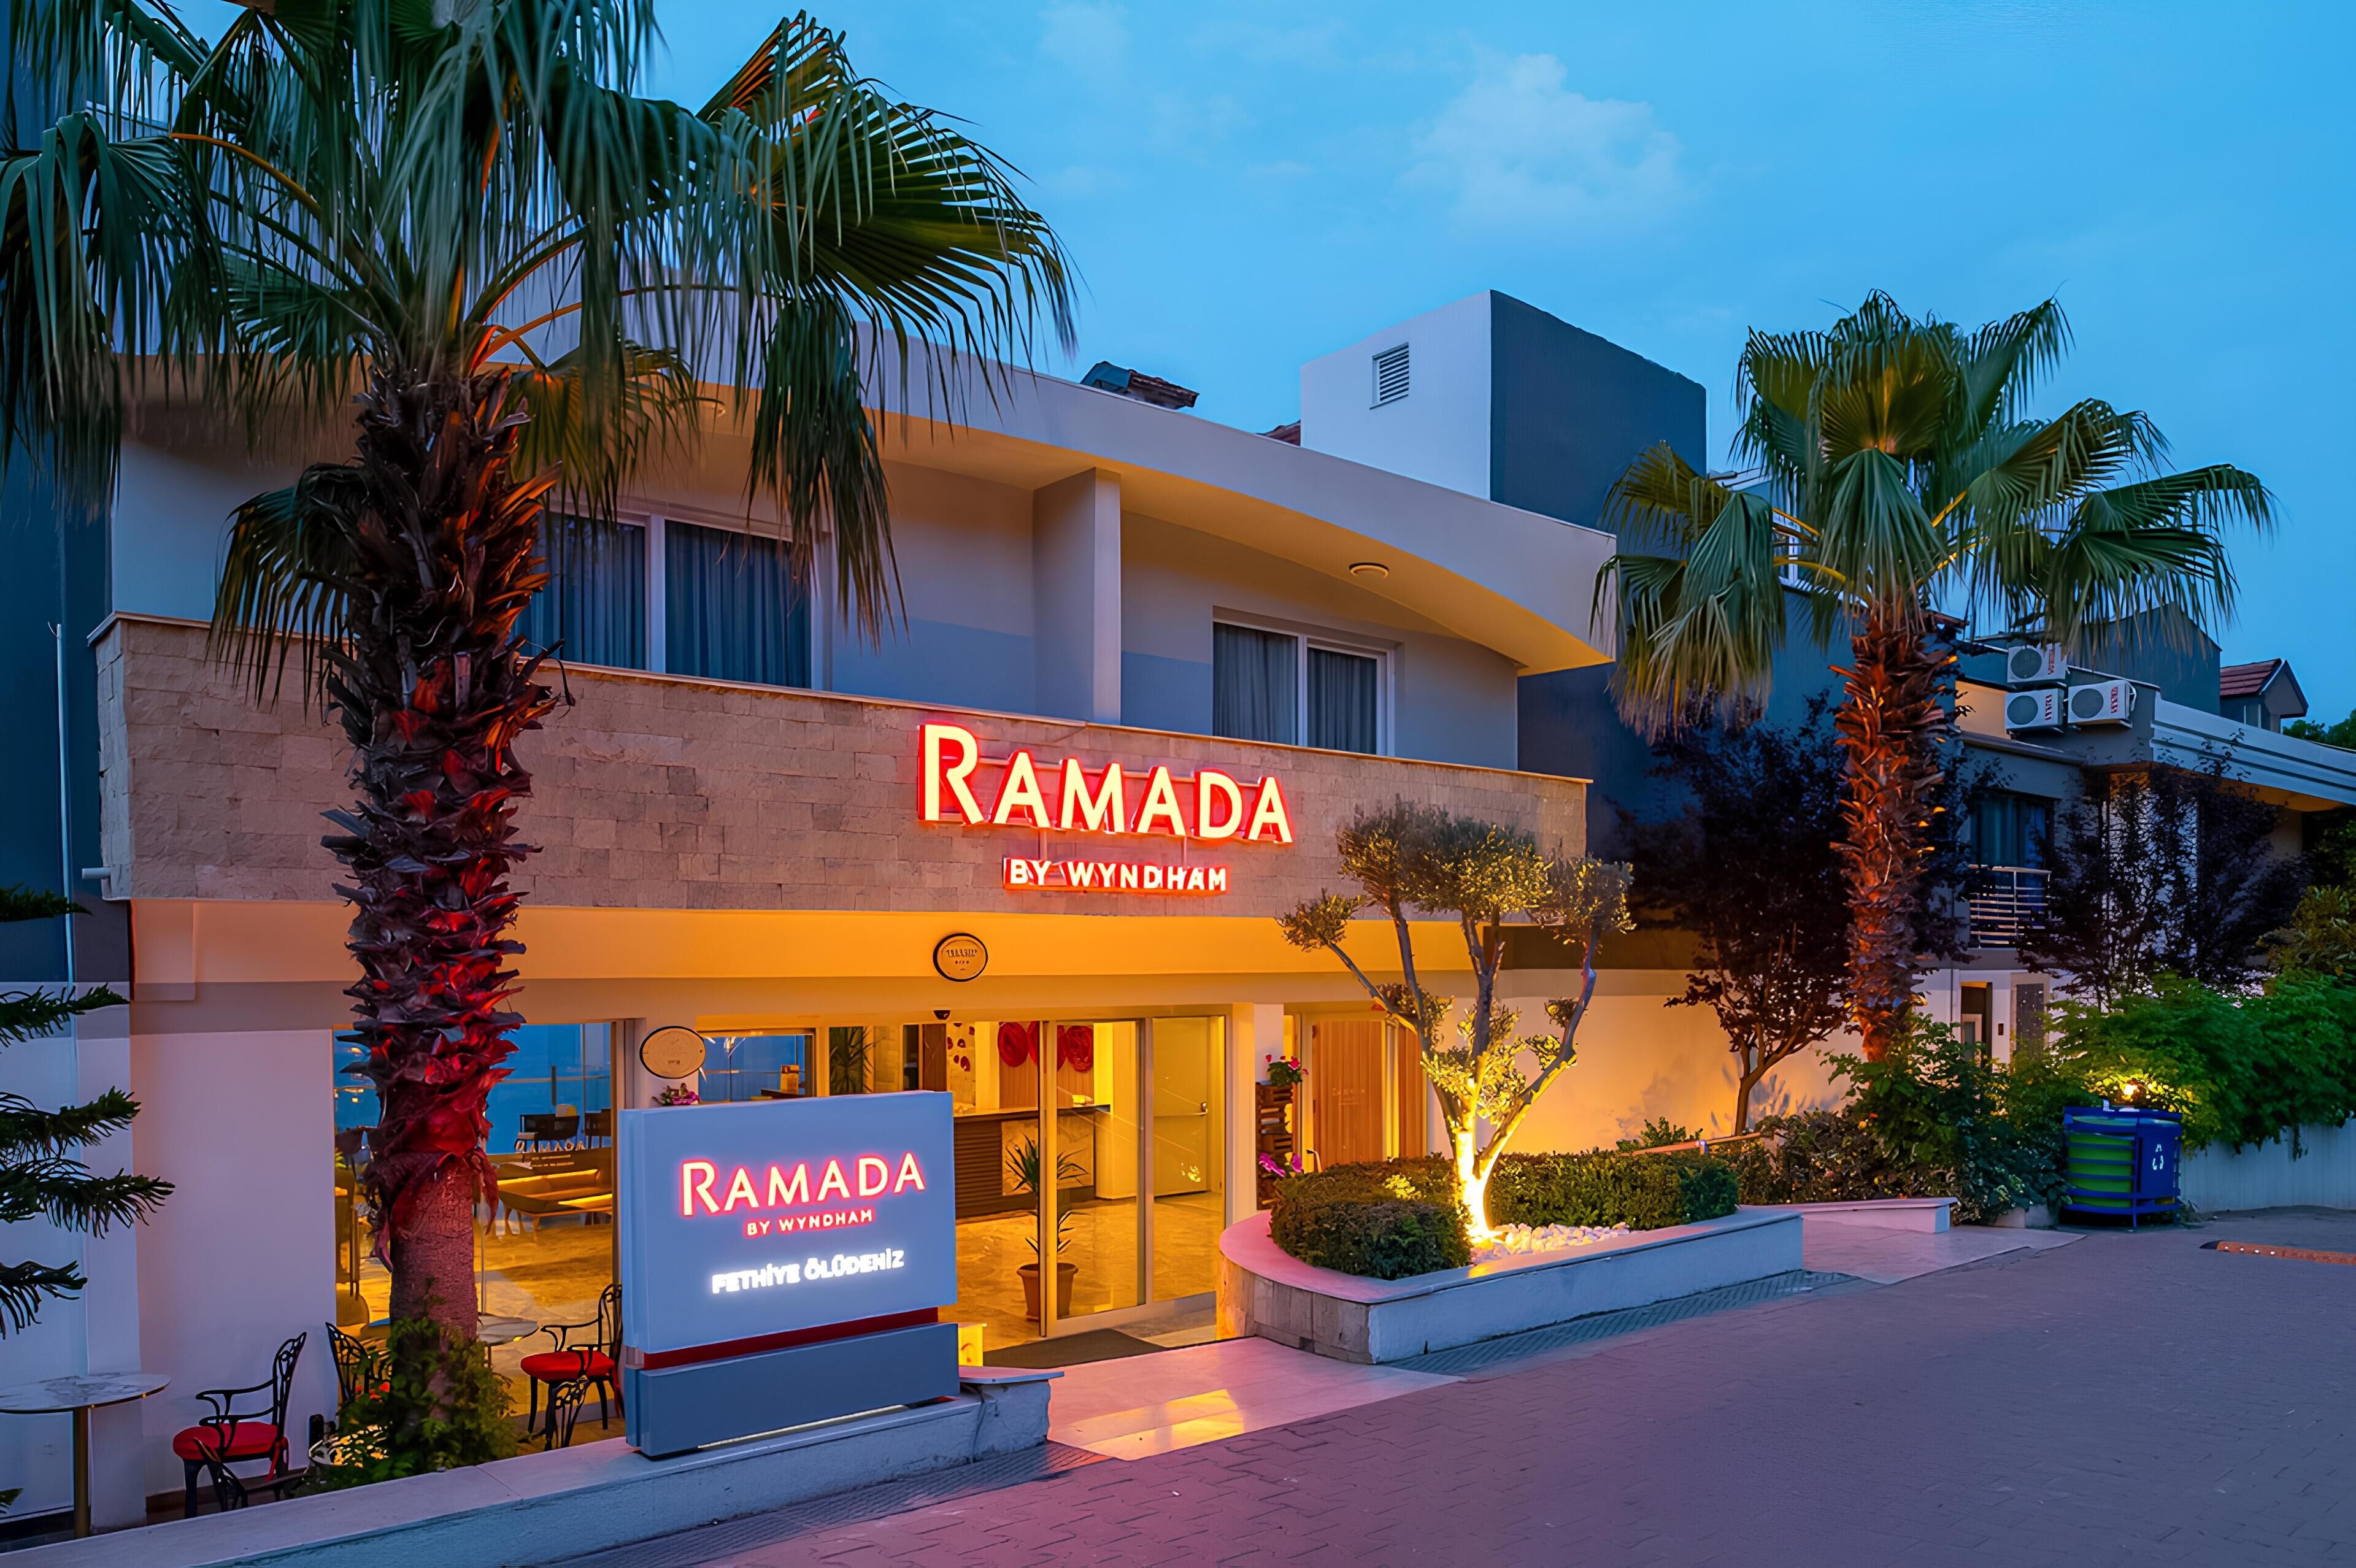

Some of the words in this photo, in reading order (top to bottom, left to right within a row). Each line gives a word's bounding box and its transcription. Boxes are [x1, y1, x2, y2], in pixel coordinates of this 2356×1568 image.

[922, 724, 1293, 844] RAMADA
[1009, 859, 1052, 886] BY
[1066, 861, 1226, 891] WYNDHAM
[683, 1153, 925, 1216] RAMADA
[747, 1220, 771, 1236] BY
[779, 1209, 872, 1232] WYNDHAM
